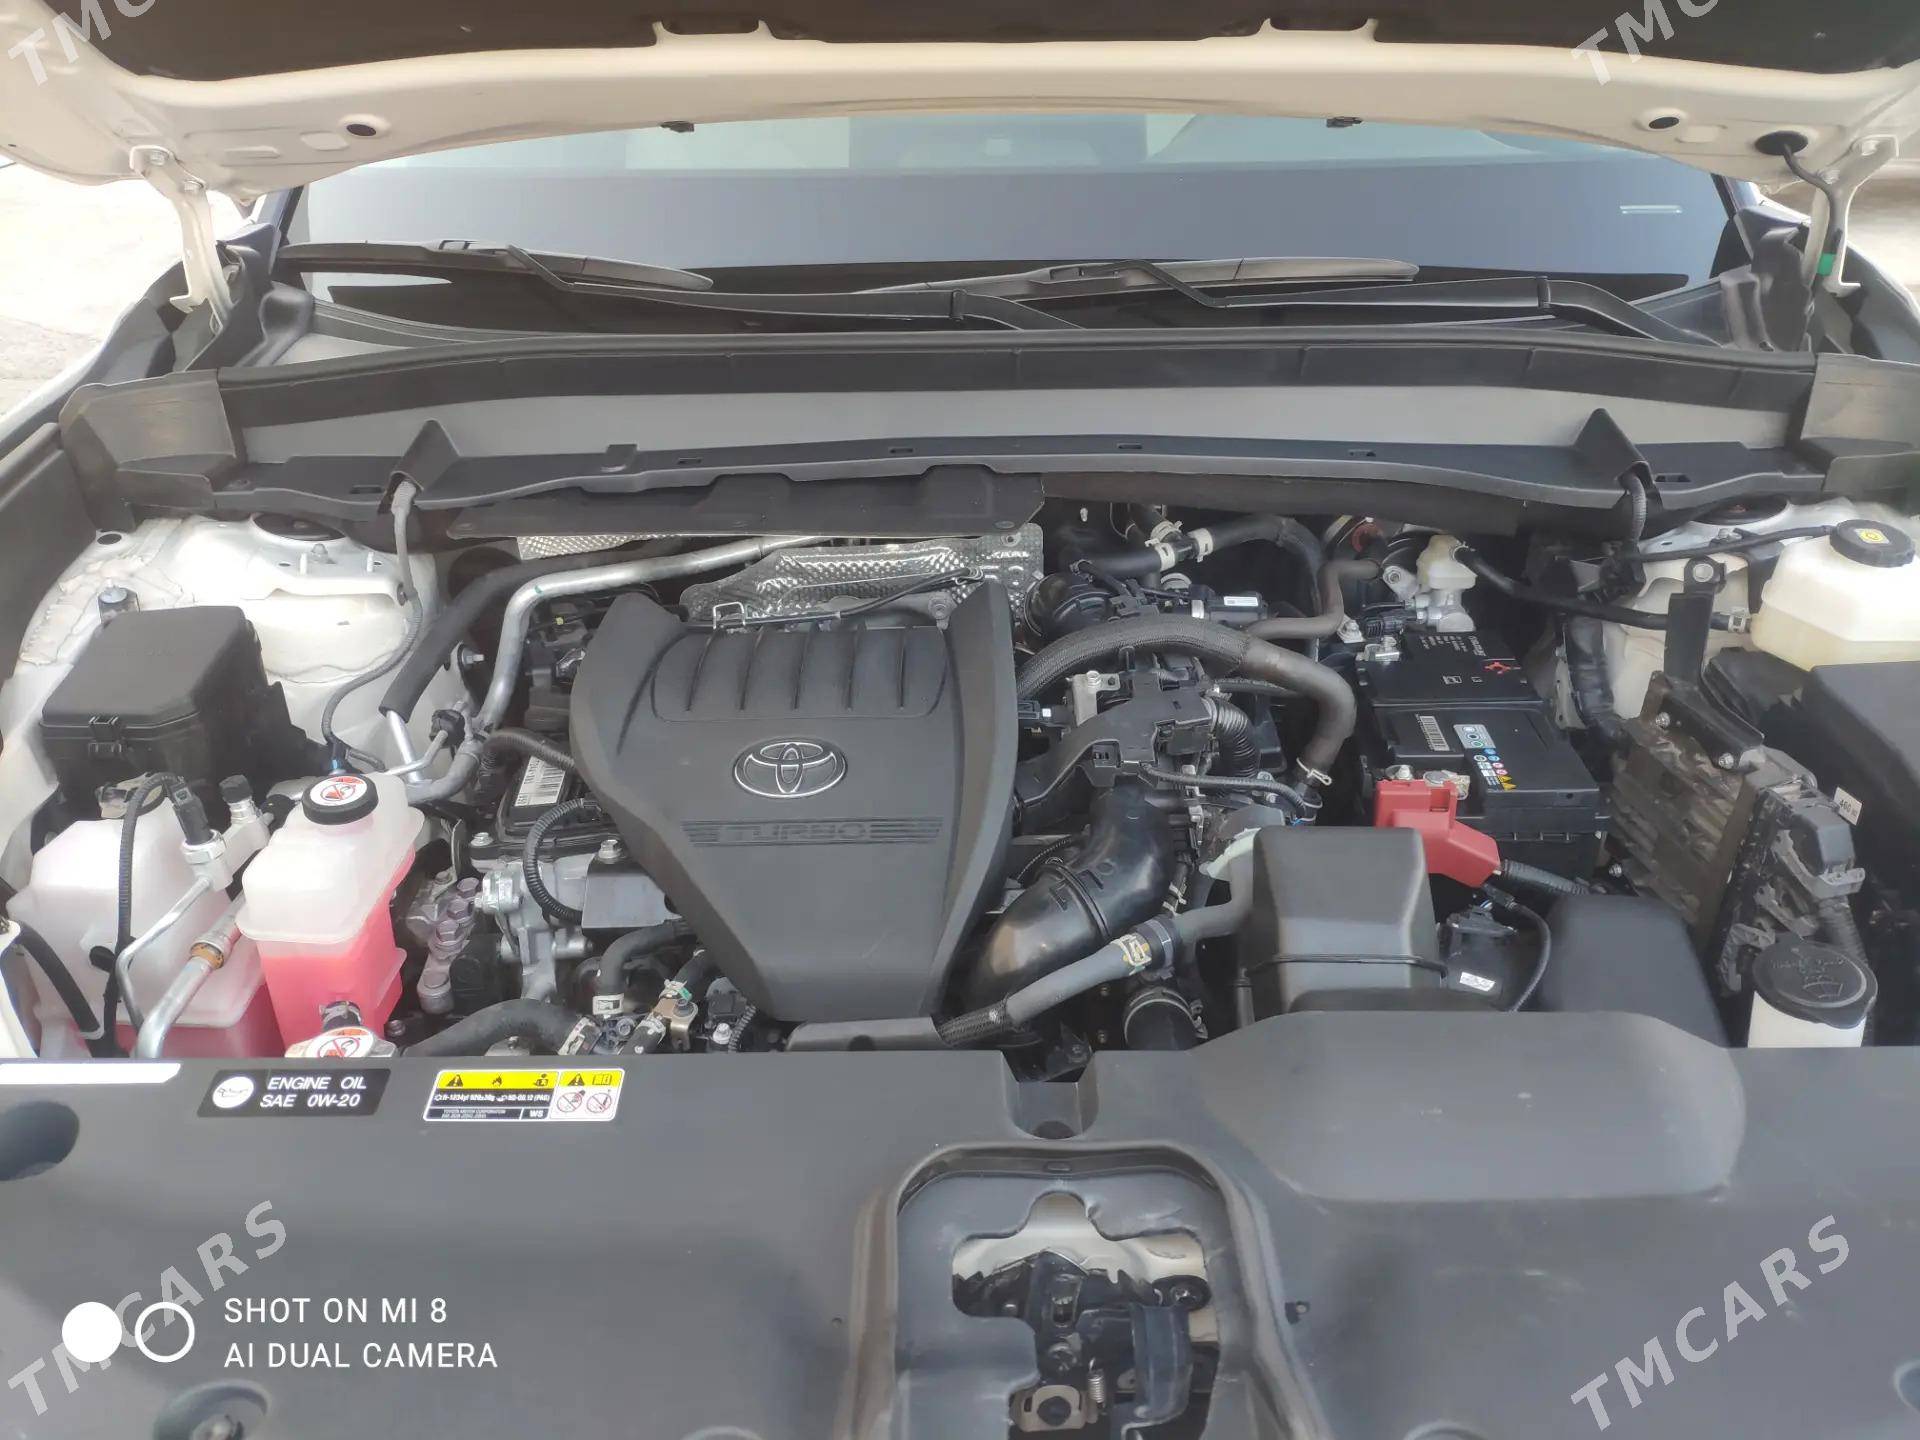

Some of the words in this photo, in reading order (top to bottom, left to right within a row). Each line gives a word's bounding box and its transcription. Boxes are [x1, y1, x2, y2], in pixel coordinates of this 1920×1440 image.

[724, 823, 867, 841] TURBO
[267, 1076, 331, 1090] ENGINE
[341, 1076, 366, 1090] OIL
[260, 1094, 297, 1108] SAE
[307, 1093, 360, 1108] 0W-20
[529, 1110, 544, 1118] WS
